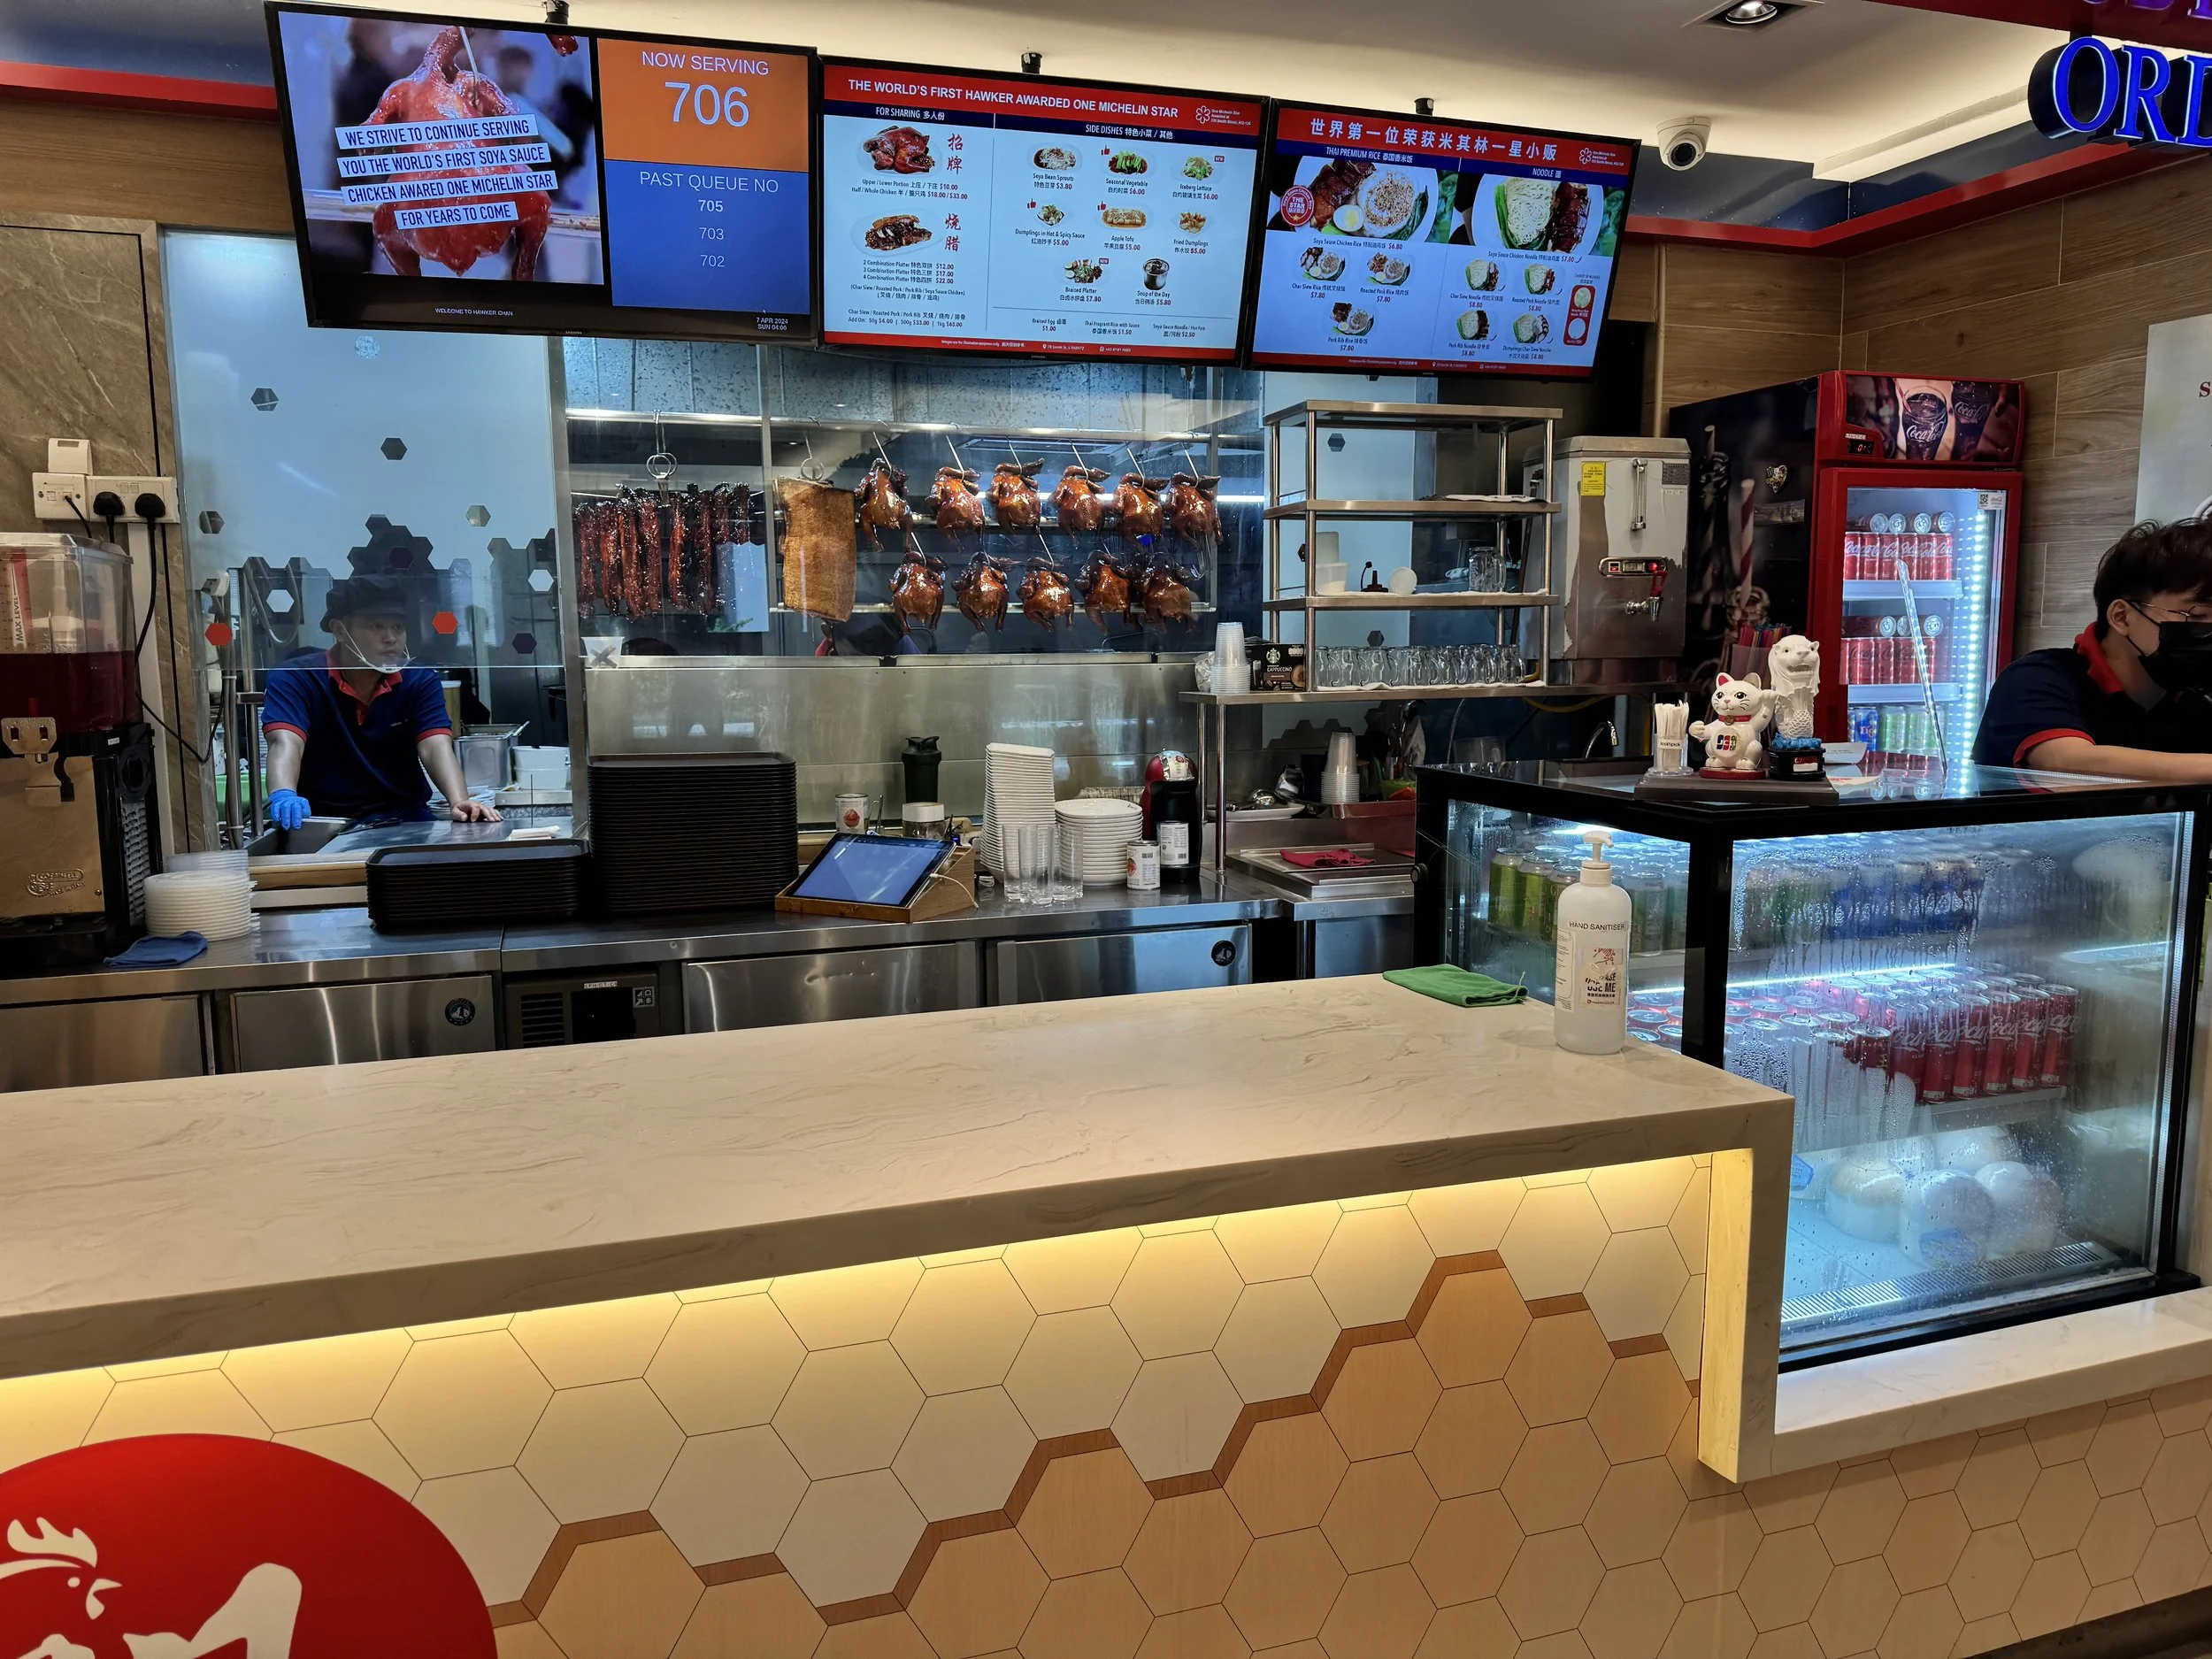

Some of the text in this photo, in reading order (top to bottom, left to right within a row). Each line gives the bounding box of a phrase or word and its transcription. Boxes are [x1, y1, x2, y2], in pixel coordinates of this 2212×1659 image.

[642, 51, 769, 75] NOW SERVING
[665, 81, 749, 127] 706
[849, 80, 1178, 118] THE WORLD'S FIRST HAWKER AWARDED ONE MICHELIN STAR
[876, 107, 945, 120] FOR SHARING 多人份
[345, 120, 529, 146] WE STRIVE TO CONTINUE SERVING
[1125, 127, 1151, 138] 特色小菜
[1159, 130, 1173, 139] 其他
[342, 147, 544, 175] YOU THE WORLD'S FIRST SOYA SAUCE
[947, 134, 964, 174] 招牌
[1326, 147, 1340, 156] THAI
[1340, 148, 1367, 158] PREMIUM
[1369, 150, 1380, 160] RICE
[1532, 168, 1554, 177] NOODLE
[348, 174, 552, 203] CHICKEN AWARED ONE MICHELIN STAR
[640, 172, 779, 192] PAST QUEUE NO
[698, 200, 723, 211] 705
[401, 204, 511, 226] FOR YEARS TO COME
[699, 227, 724, 240] 703
[701, 255, 725, 266] 702
[1717, 736, 1736, 749] JCB
[1605, 983, 1616, 992] ME
